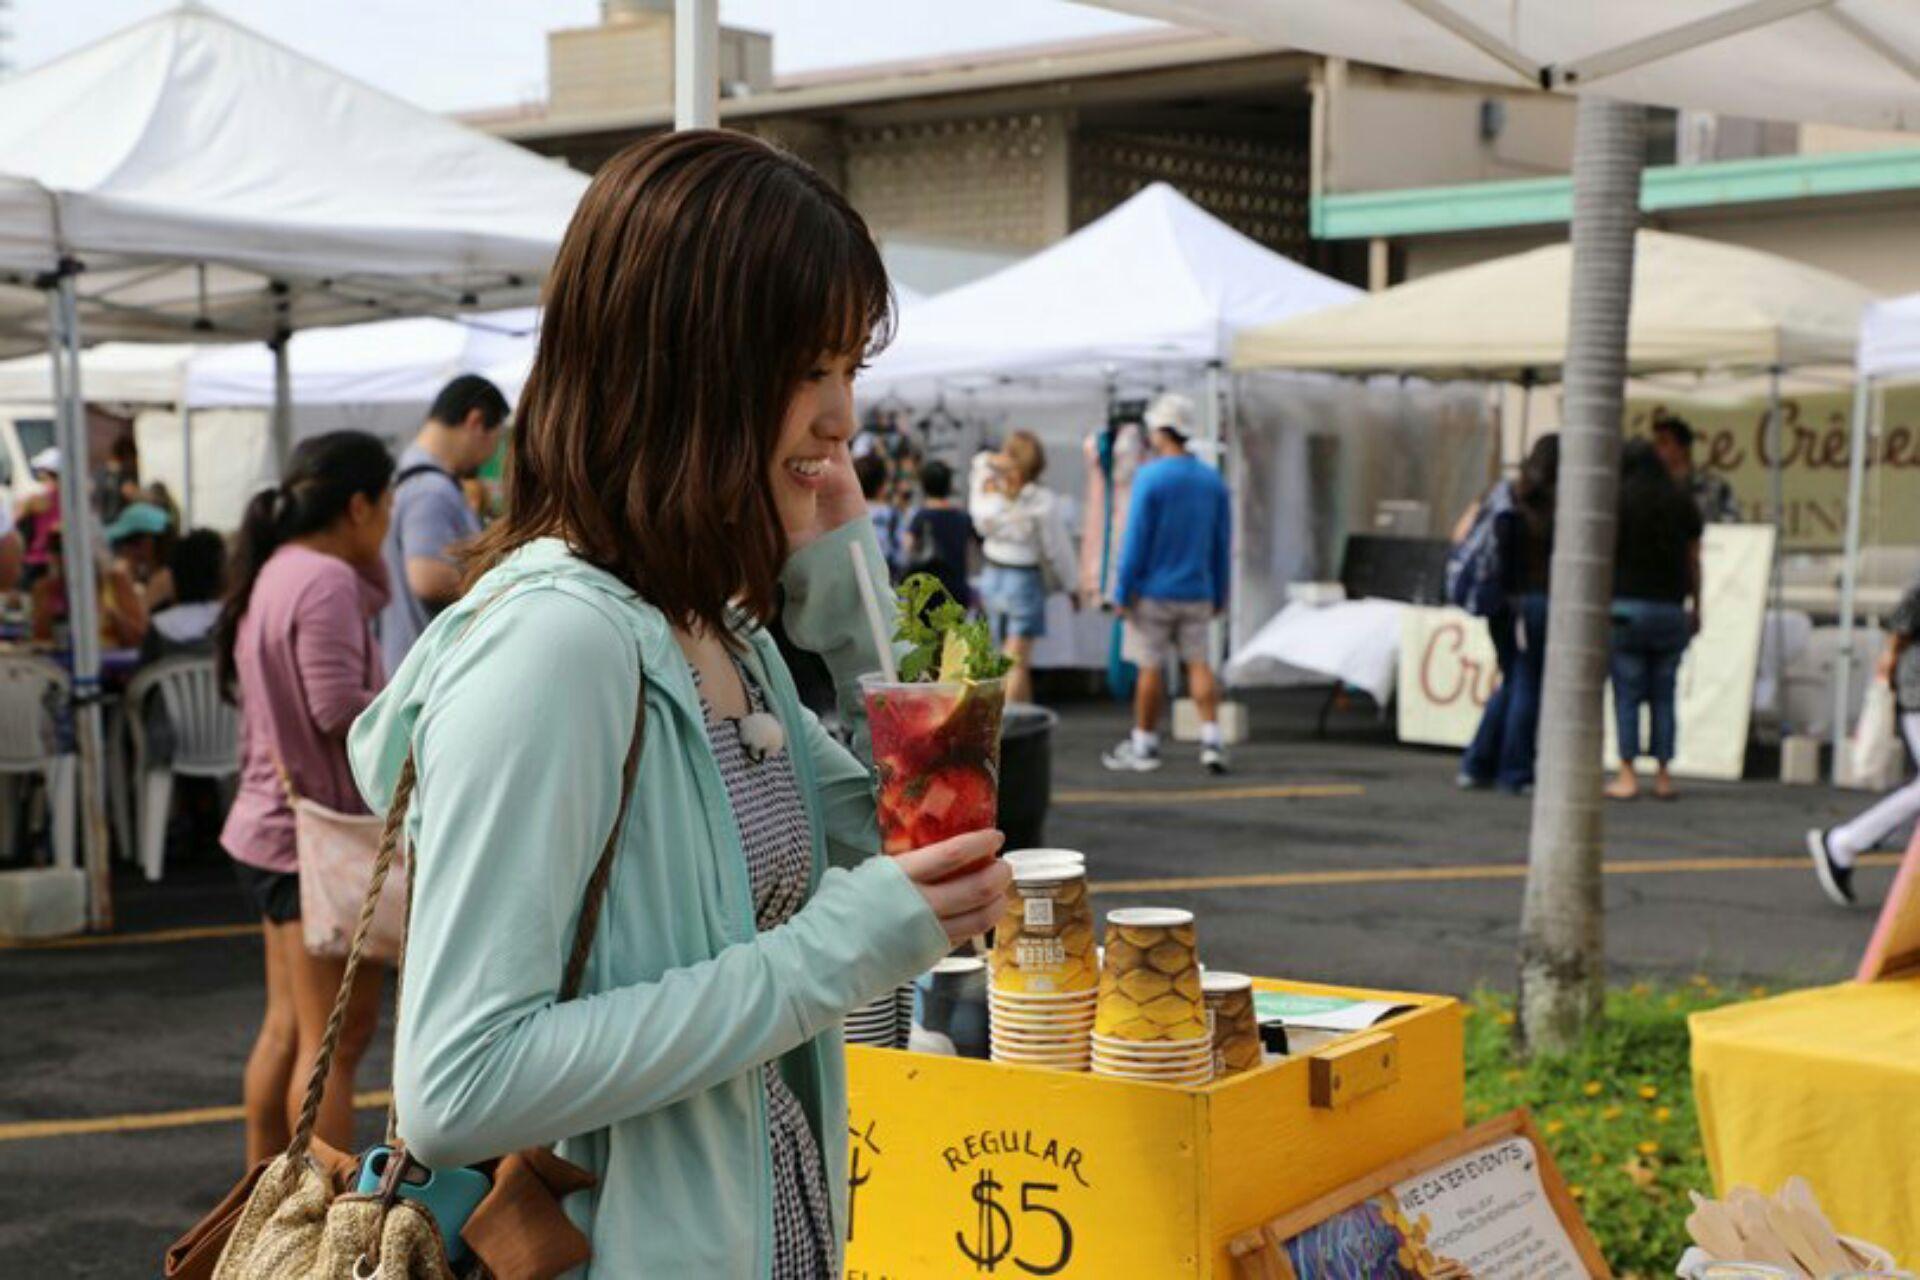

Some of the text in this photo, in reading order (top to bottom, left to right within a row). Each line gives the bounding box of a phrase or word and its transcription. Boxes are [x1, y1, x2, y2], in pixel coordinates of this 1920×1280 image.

[943, 1130, 1090, 1187] REGULAR
[1422, 1168, 1466, 1200] CATER
[1465, 1143, 1523, 1179] EVENTS
[956, 1168, 1073, 1276] $5
